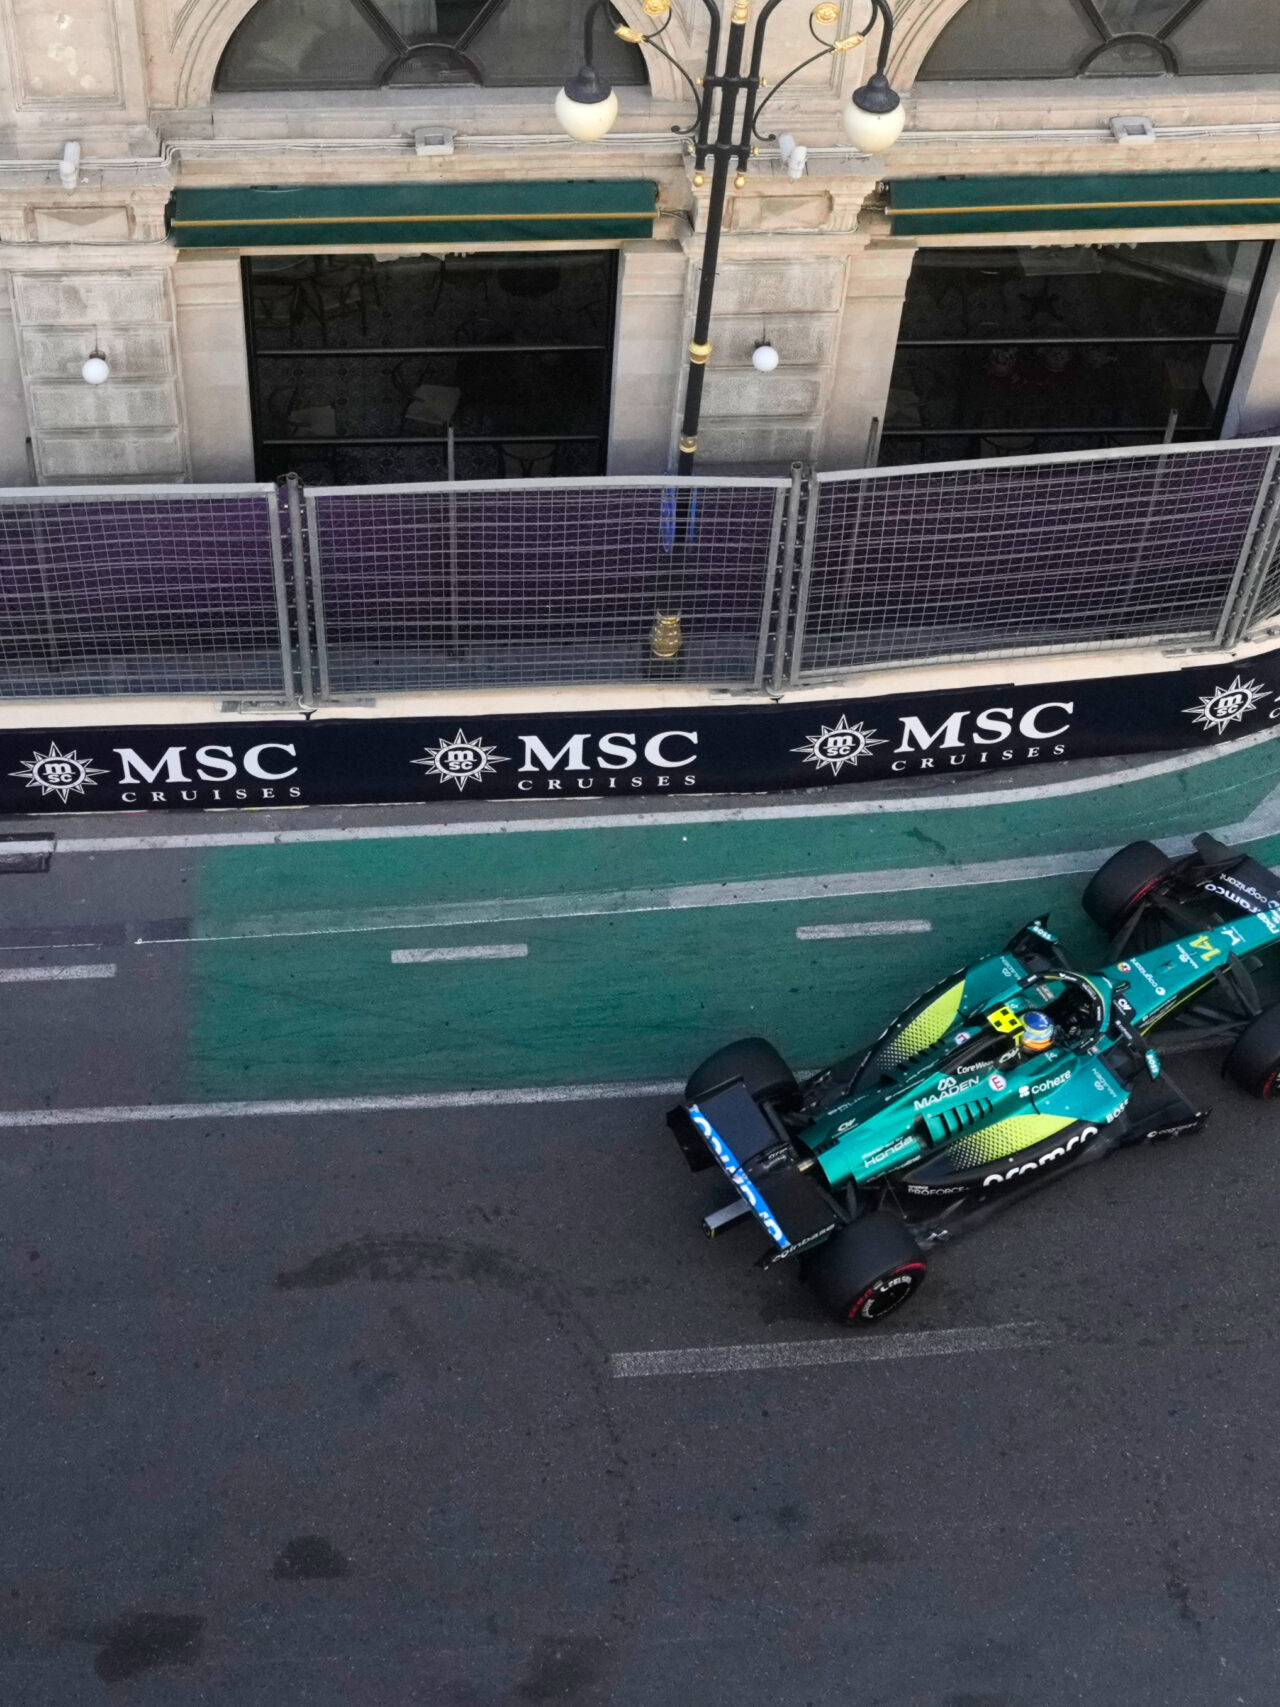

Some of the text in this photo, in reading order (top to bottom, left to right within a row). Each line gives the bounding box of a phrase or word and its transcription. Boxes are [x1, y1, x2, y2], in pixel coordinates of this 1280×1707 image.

[893, 702, 1074, 754] MSC
[112, 744, 298, 785] MSC
[518, 731, 699, 771] MSC
[891, 745, 1065, 772] CRUISES
[121, 788, 301, 803] CRUISES
[518, 776, 696, 791] CRUISES
[1204, 884, 1261, 913] ramco
[1219, 873, 1267, 903] cognizant
[1189, 934, 1221, 962] 14
[1130, 958, 1158, 988] cognizant
[914, 1076, 980, 1111] MAADEN
[1032, 1070, 1071, 1095] cohere
[864, 1136, 914, 1168] Honda
[771, 1223, 835, 1264] coinbase
